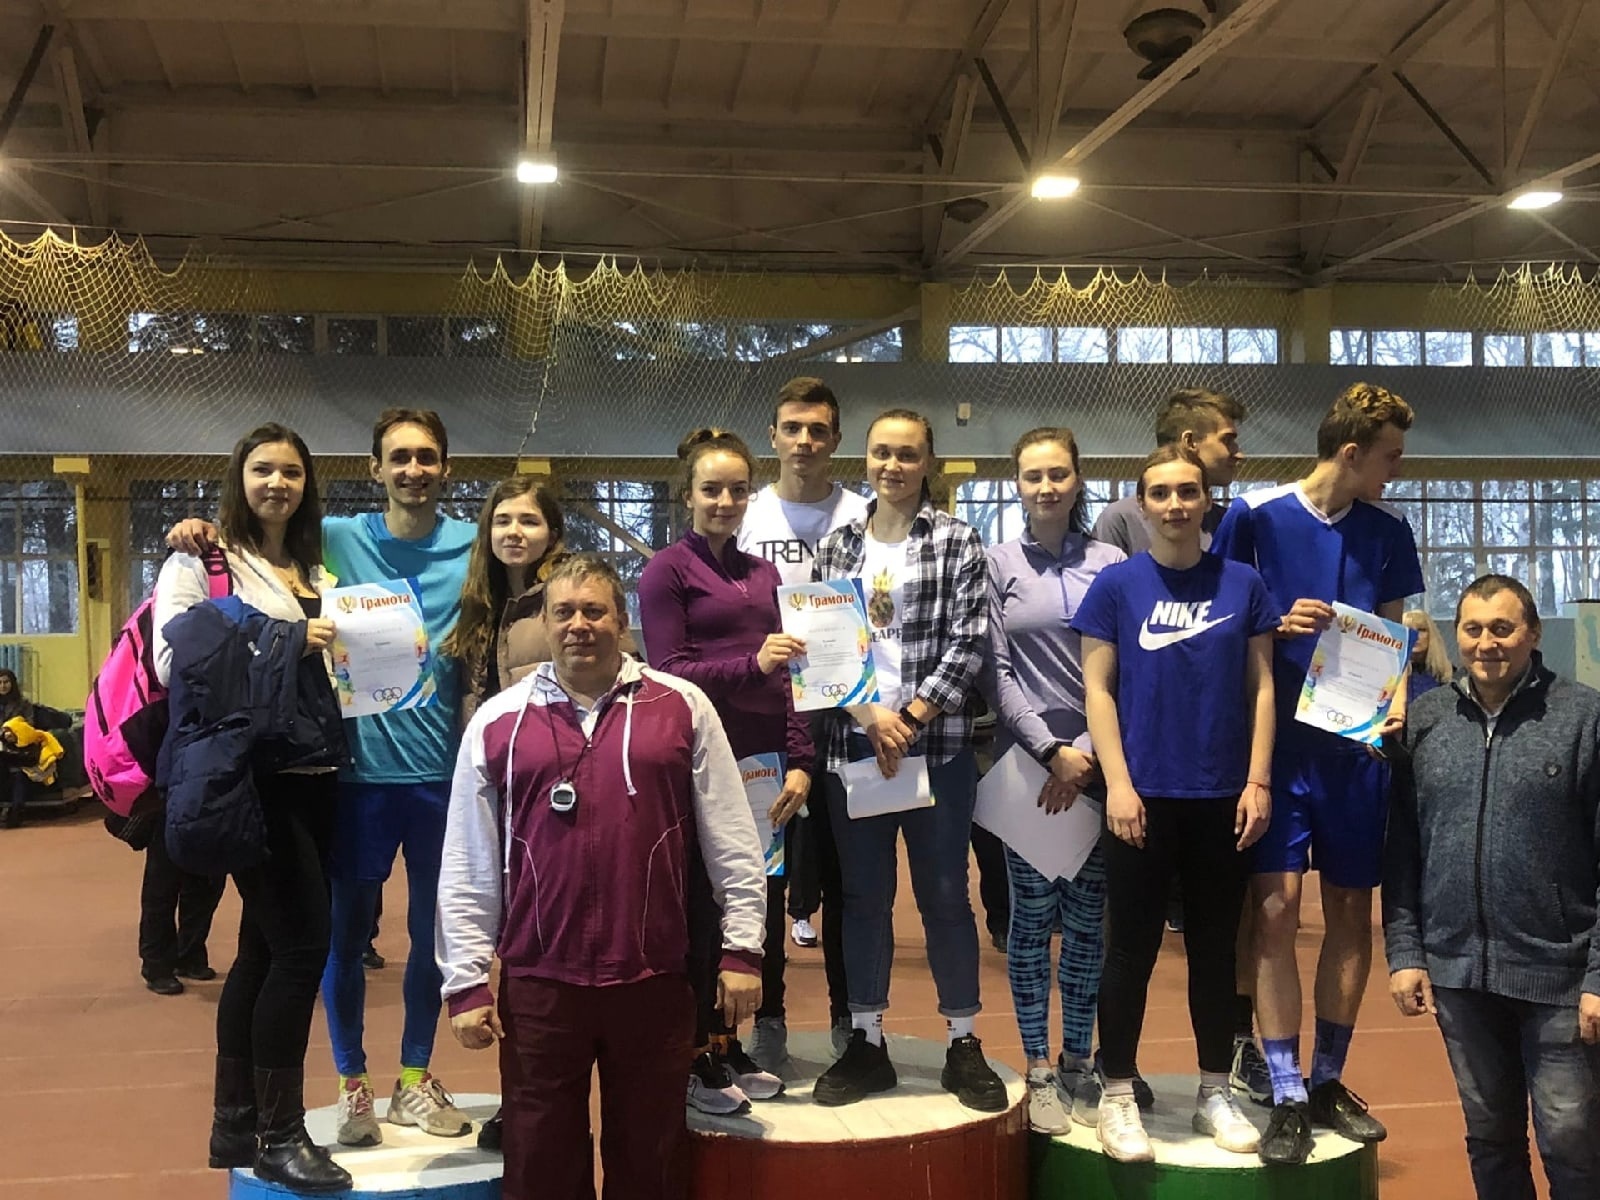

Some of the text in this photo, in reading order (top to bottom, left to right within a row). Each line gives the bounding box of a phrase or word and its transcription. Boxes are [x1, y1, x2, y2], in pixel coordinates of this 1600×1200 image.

[360, 595, 411, 611] Грамота
[809, 594, 855, 609] Грамота
[1149, 600, 1213, 629] NIKE
[1356, 623, 1403, 650] Грамота
